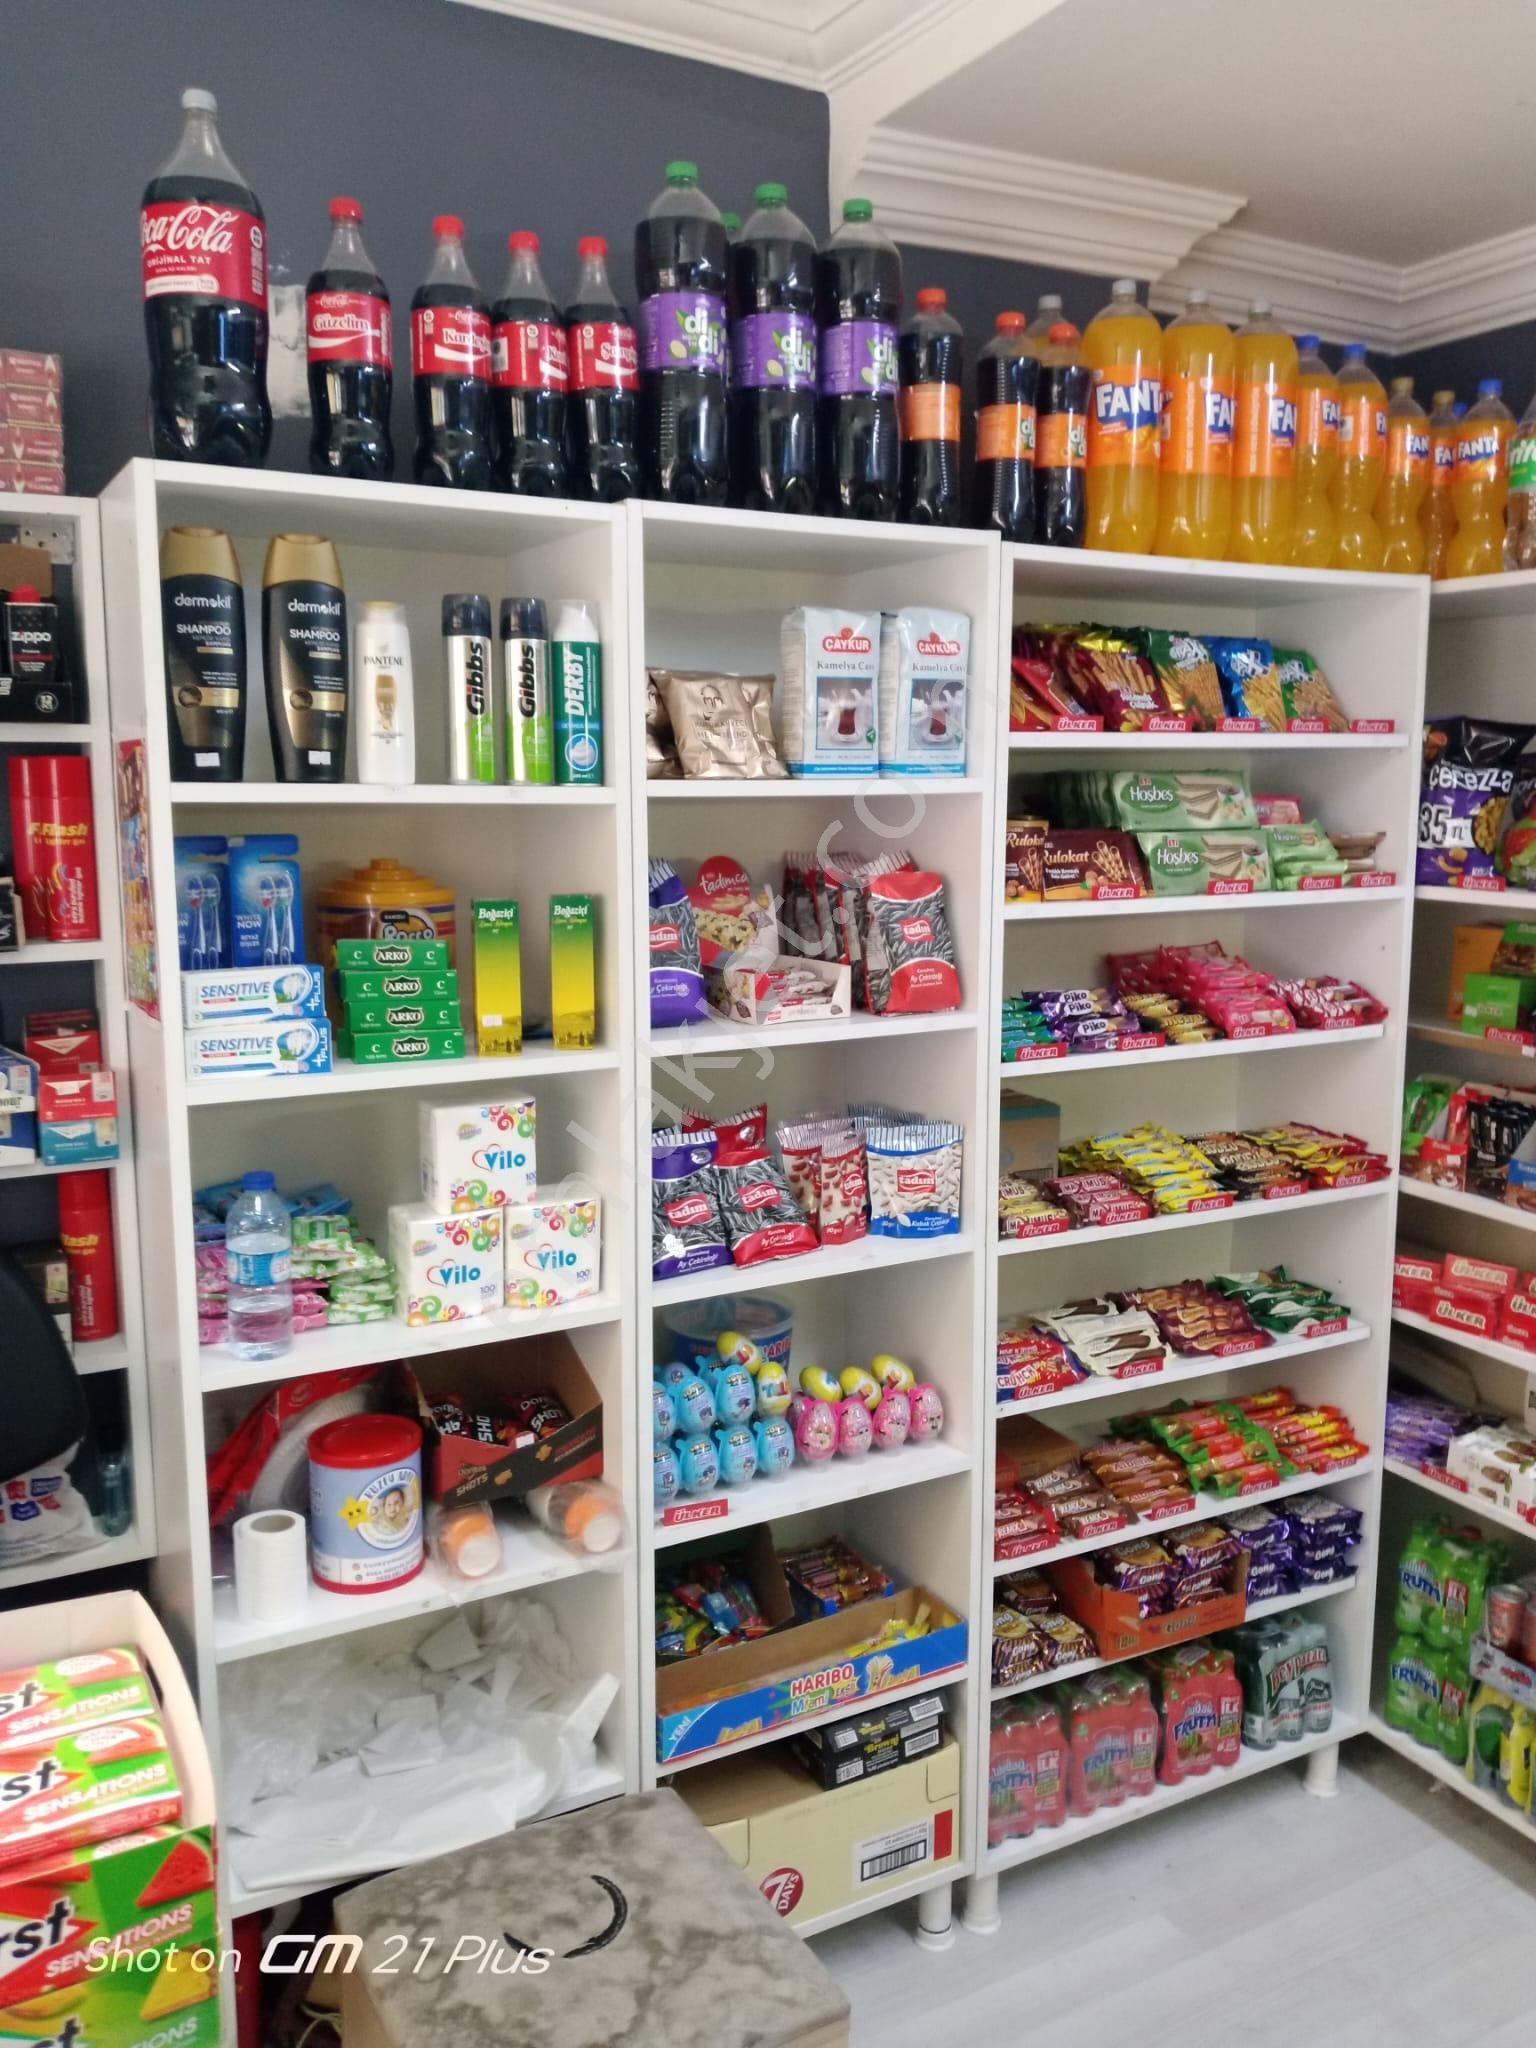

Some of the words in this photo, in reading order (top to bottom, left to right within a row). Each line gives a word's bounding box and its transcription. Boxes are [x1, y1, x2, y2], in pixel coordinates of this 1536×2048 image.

[1096, 380, 1162, 418] FANT
[176, 624, 231, 636] SHAMPOO
[289, 629, 340, 641] SHAMPOO
[465, 641, 485, 716] Gibbs
[519, 644, 535, 718] Gibbs
[564, 650, 586, 717] DERBY
[1058, 718, 1096, 730] ÜLKER
[1149, 719, 1185, 730] ÜLKER
[1098, 886, 1135, 898] ÜLKER
[1215, 882, 1248, 894] ÜLKER
[650, 931, 678, 942] adım
[377, 951, 409, 961] ARKO
[201, 980, 270, 998] SENSITIVE
[387, 982, 418, 992] ARKO
[1064, 990, 1087, 1001] Piko
[1069, 1001, 1092, 1011] Piko
[390, 1012, 421, 1022] ARKO
[1082, 1021, 1106, 1033] Piko
[200, 1037, 274, 1051] SENSITIVE
[395, 1043, 426, 1053] ARKO
[1122, 1037, 1157, 1049] ÜLKER
[1021, 1047, 1058, 1059] ÜLKER
[484, 1150, 526, 1171] Vilo
[899, 1174, 935, 1186] tadım
[741, 1187, 778, 1204] tadım
[668, 1201, 708, 1219] tadım
[537, 1249, 577, 1271] Vilo
[440, 1266, 481, 1288] Vilo
[1451, 1259, 1508, 1286] ÜLKER
[1435, 1300, 1486, 1329] ÜLKER
[997, 1365, 1035, 1389] CRUNCH
[673, 1505, 721, 1523] ÜLKER
[1140, 1571, 1164, 1585] Gong
[791, 1663, 854, 1697] HARIBO
[23, 1763, 167, 1821] SENSATIONS
[778, 1873, 800, 1910] DAYS
